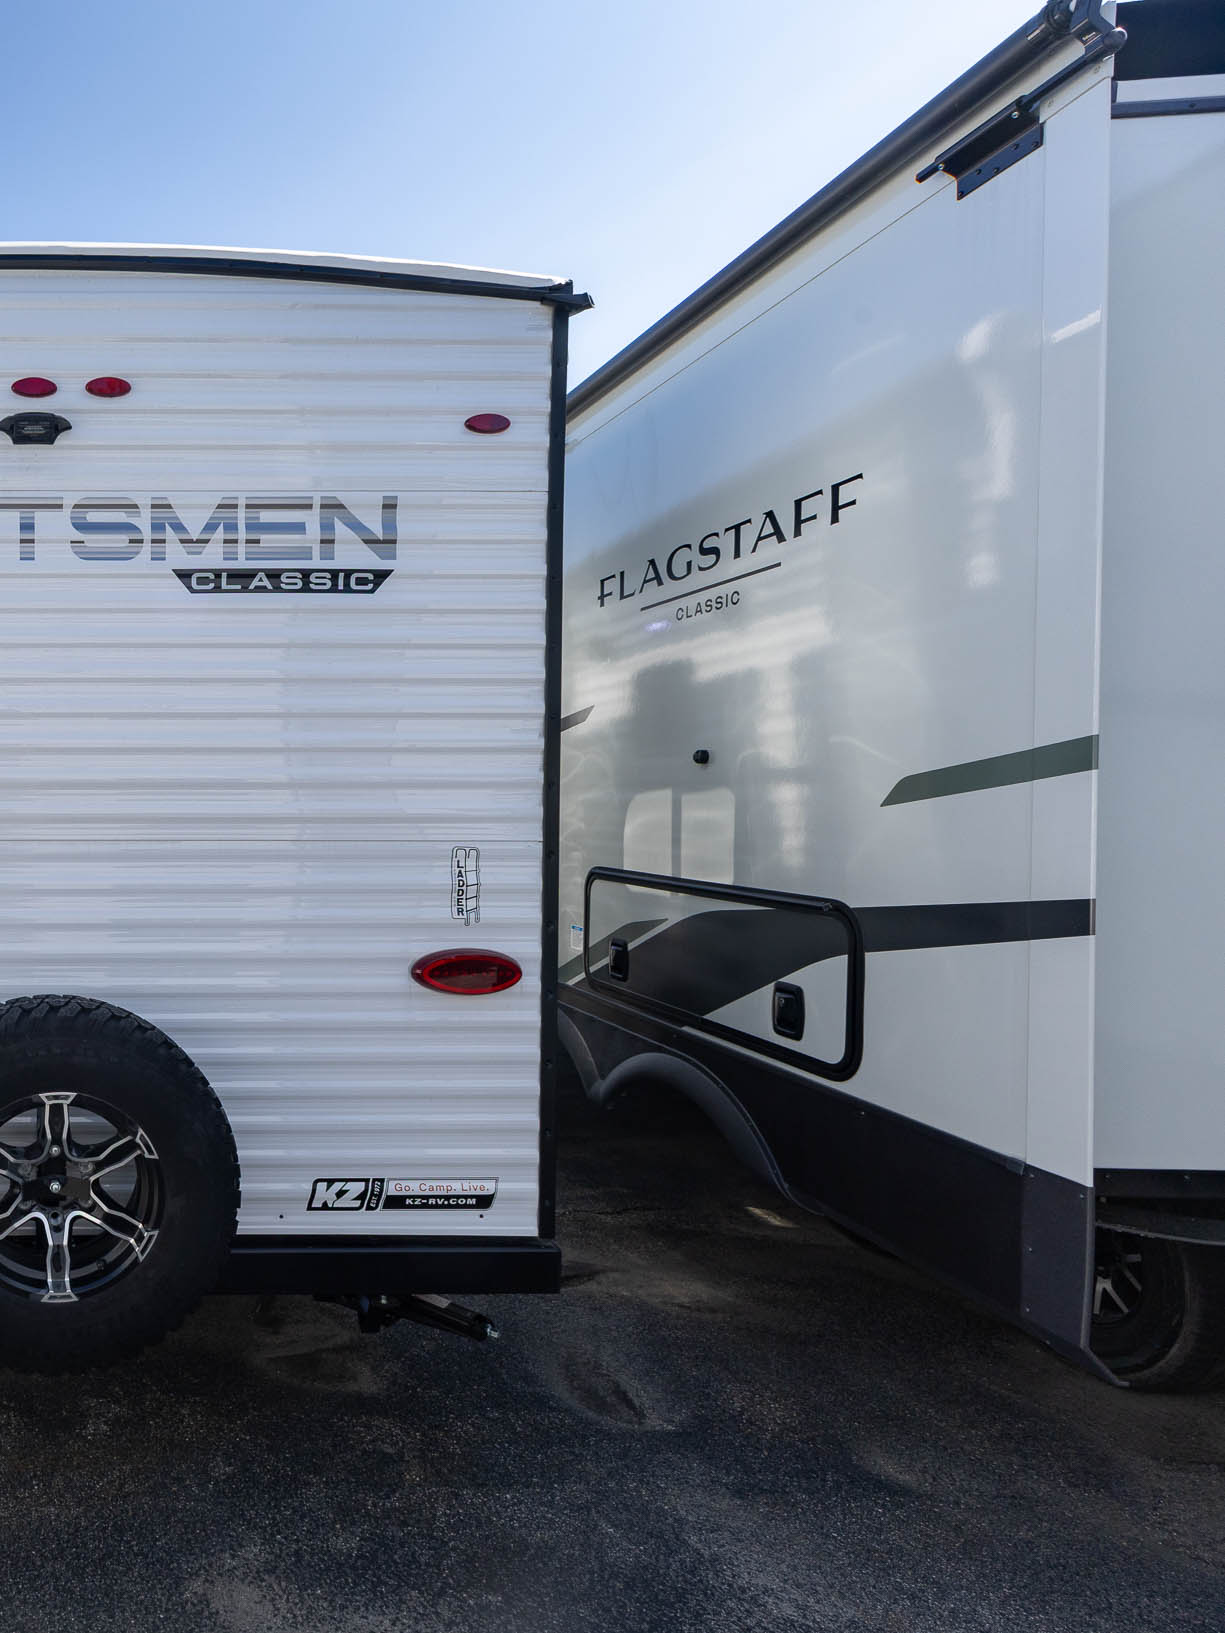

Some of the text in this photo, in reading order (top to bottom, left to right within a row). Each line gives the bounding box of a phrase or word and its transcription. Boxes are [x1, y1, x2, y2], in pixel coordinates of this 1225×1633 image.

[597, 472, 864, 608] FLAGSTAFF
[191, 571, 376, 592] CLASSIC
[675, 590, 741, 622] CLASSIC
[456, 859, 465, 916] LADDER
[311, 1181, 364, 1208] KZ
[394, 1182, 490, 1193] Go. Camp. Live.
